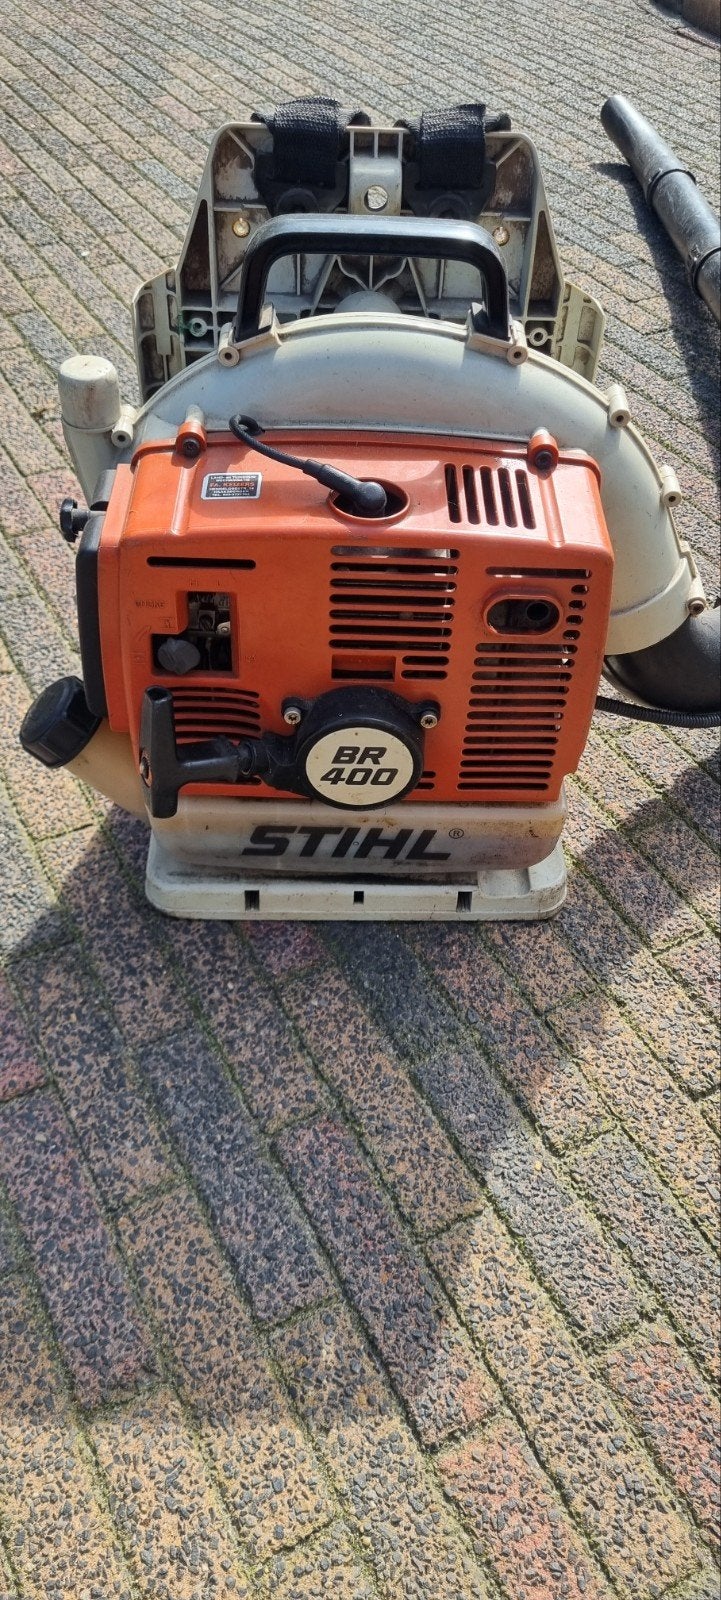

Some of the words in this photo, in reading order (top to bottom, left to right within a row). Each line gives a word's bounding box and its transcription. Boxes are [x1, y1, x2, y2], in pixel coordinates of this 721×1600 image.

[331, 746, 387, 765] BR
[320, 768, 399, 786] 400
[241, 825, 451, 860] STIHL
